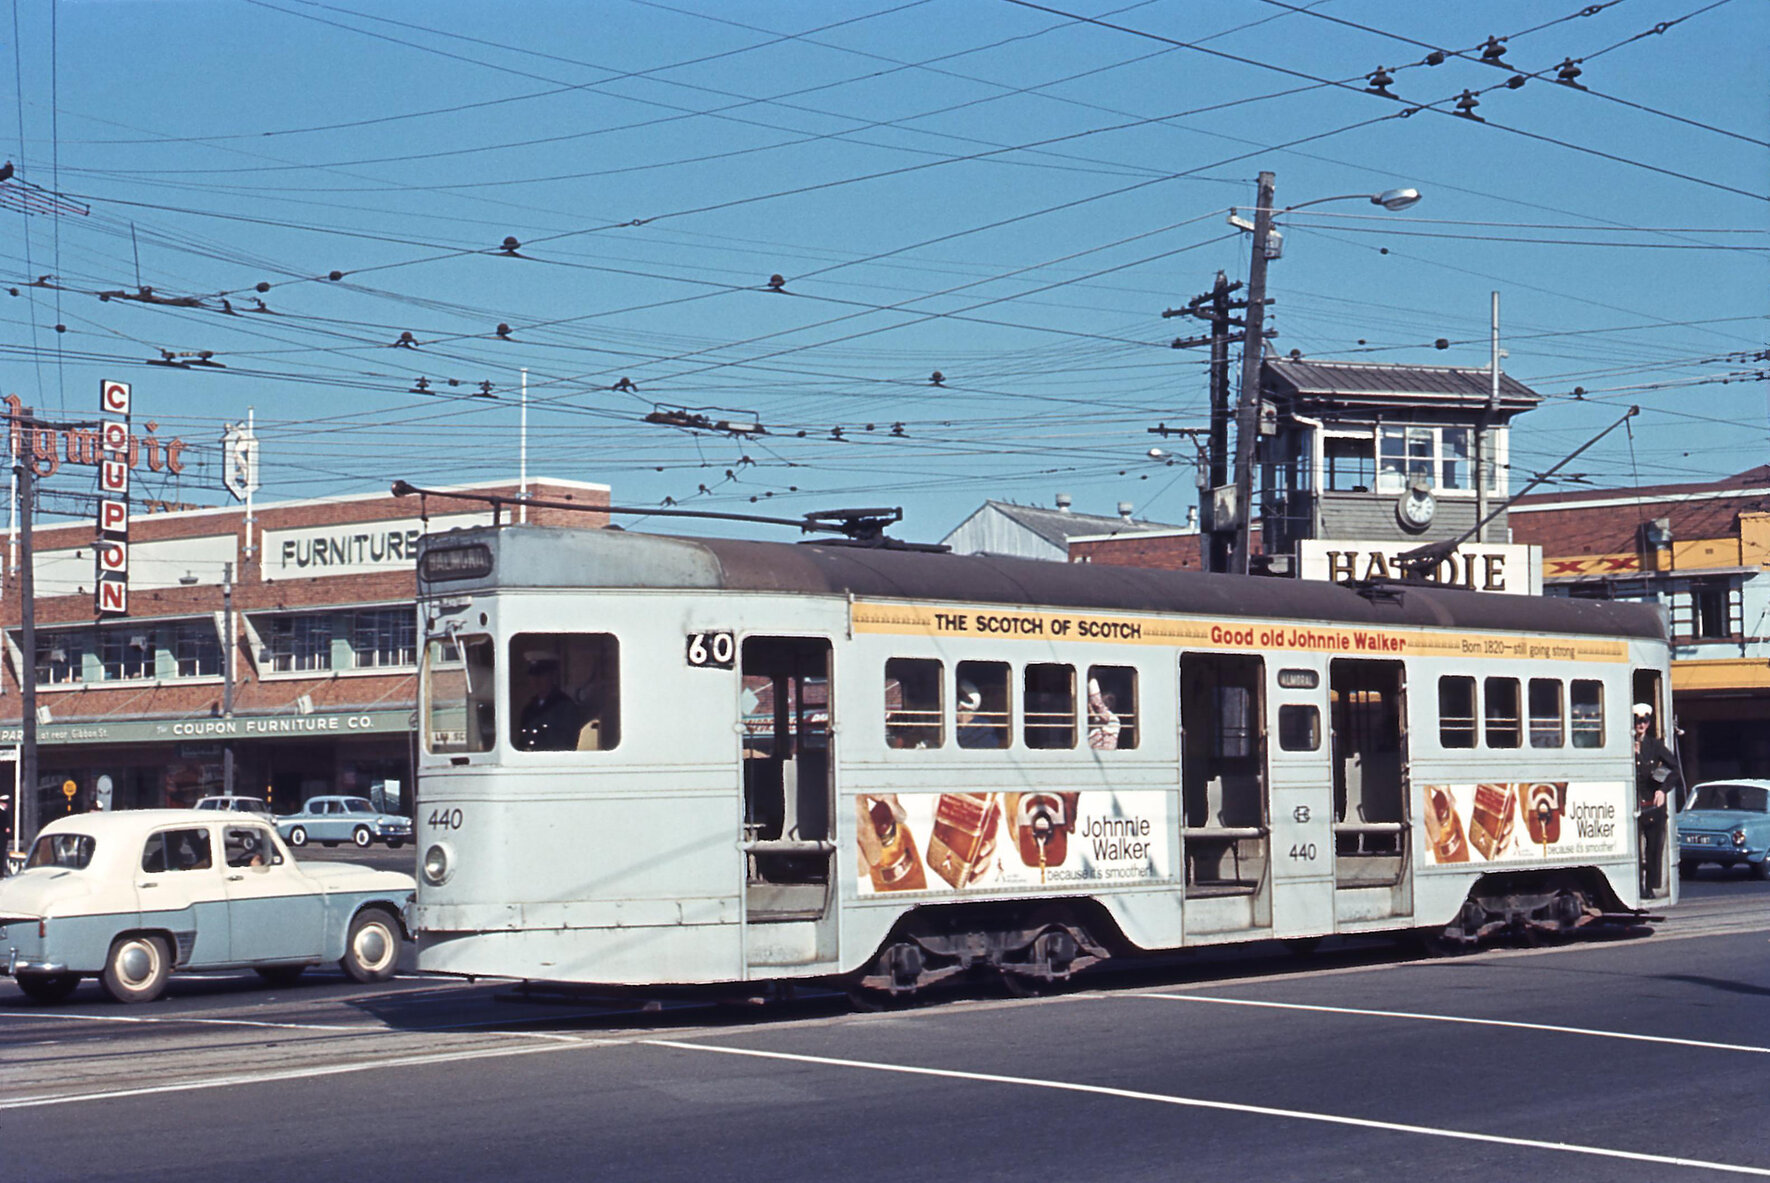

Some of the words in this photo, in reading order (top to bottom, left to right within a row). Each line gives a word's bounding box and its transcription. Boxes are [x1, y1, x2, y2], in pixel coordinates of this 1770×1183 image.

[103, 384, 126, 608] COUPON
[281, 529, 420, 569] FURNITURE
[1326, 551, 1506, 591] HADIE
[934, 613, 967, 631] THE
[976, 616, 1042, 635] SCOTCH
[1051, 619, 1071, 636] OF
[1078, 620, 1141, 639] SCOTCH
[689, 633, 733, 664] 60
[1211, 625, 1254, 646] Good
[1260, 628, 1284, 647] old
[1288, 629, 1350, 650] Johnnie
[1354, 632, 1406, 651] Walker
[1462, 639, 1482, 654] Born
[1530, 643, 1550, 659] going
[1552, 647, 1575, 660] strong
[71, 729, 98, 739] Gibbon
[173, 720, 237, 736] COUPON
[246, 717, 339, 733] FURNITURE
[347, 715, 375, 729] CO.
[428, 808, 463, 831] 440
[1570, 802, 1615, 820] Johnnie
[1082, 815, 1150, 838] Johnnie
[1576, 820, 1615, 839] Walker
[1092, 838, 1150, 861] Walker
[1289, 843, 1316, 861] 440
[1547, 845, 1574, 855] because
[1047, 865, 1088, 881] because
[1090, 865, 1103, 879] it's
